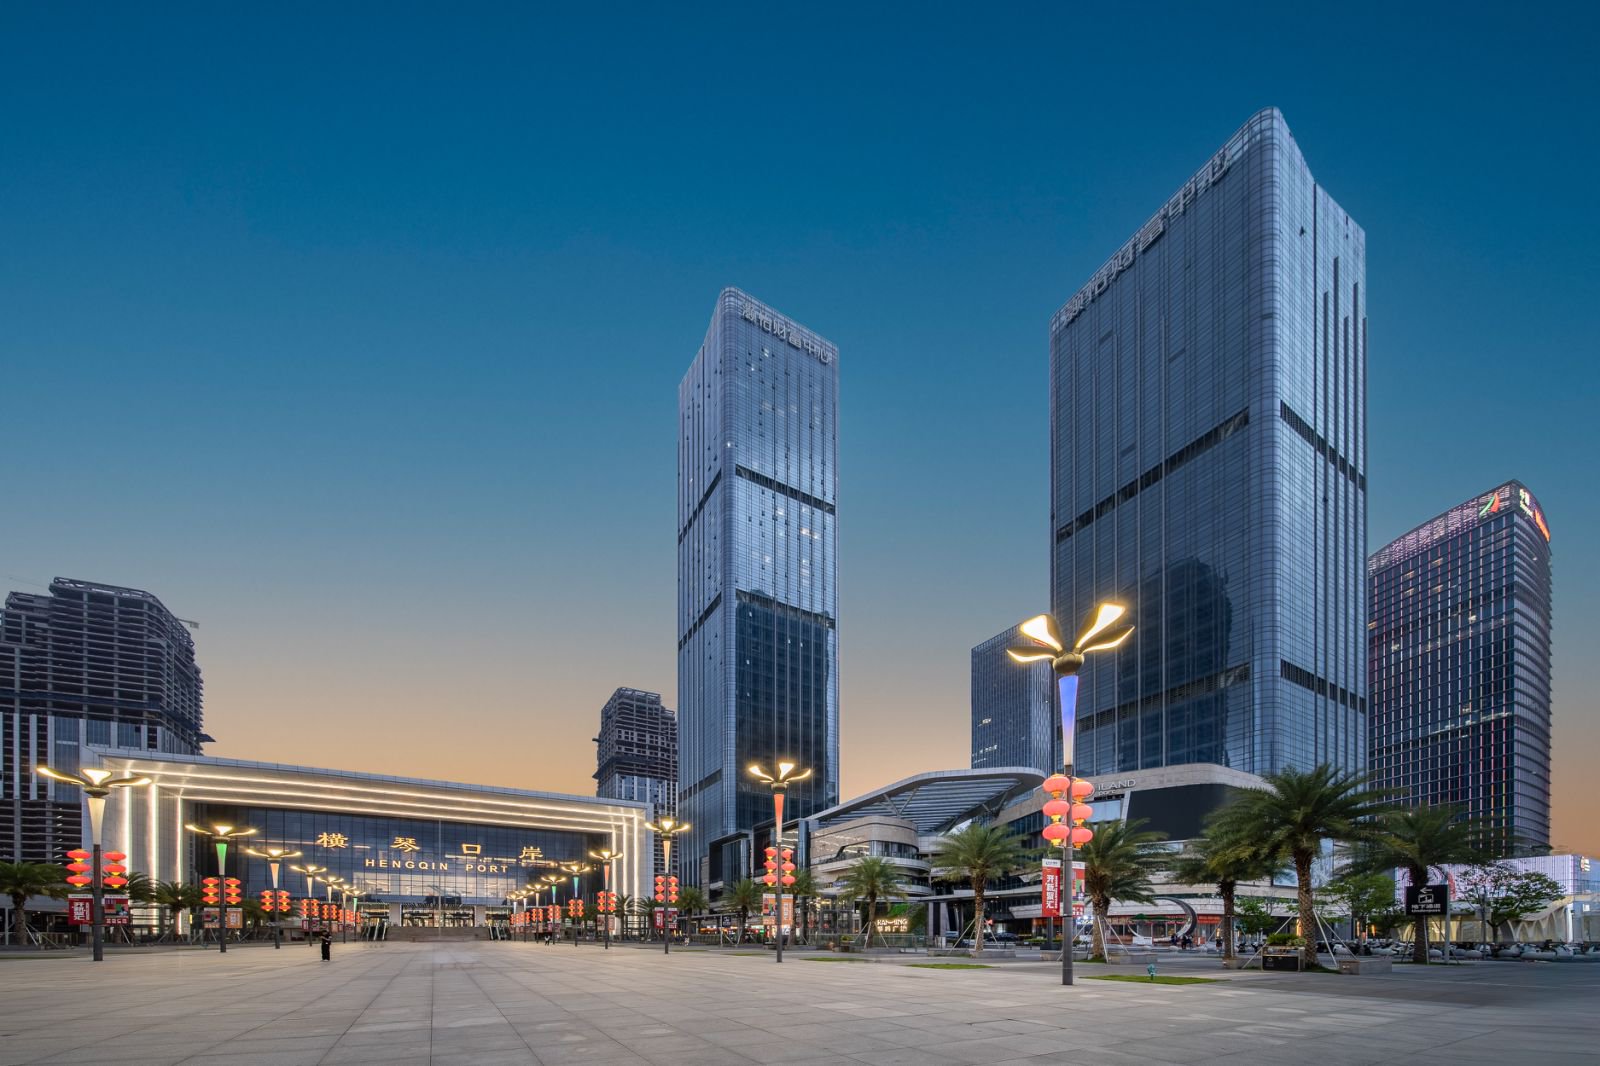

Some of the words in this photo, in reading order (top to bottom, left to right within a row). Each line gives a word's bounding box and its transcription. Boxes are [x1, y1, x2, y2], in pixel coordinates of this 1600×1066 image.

[1098, 779, 1136, 791] ILAND
[317, 832, 543, 861] 横琴口岸
[365, 858, 448, 871] HENGQIN
[465, 864, 508, 874] PORT
